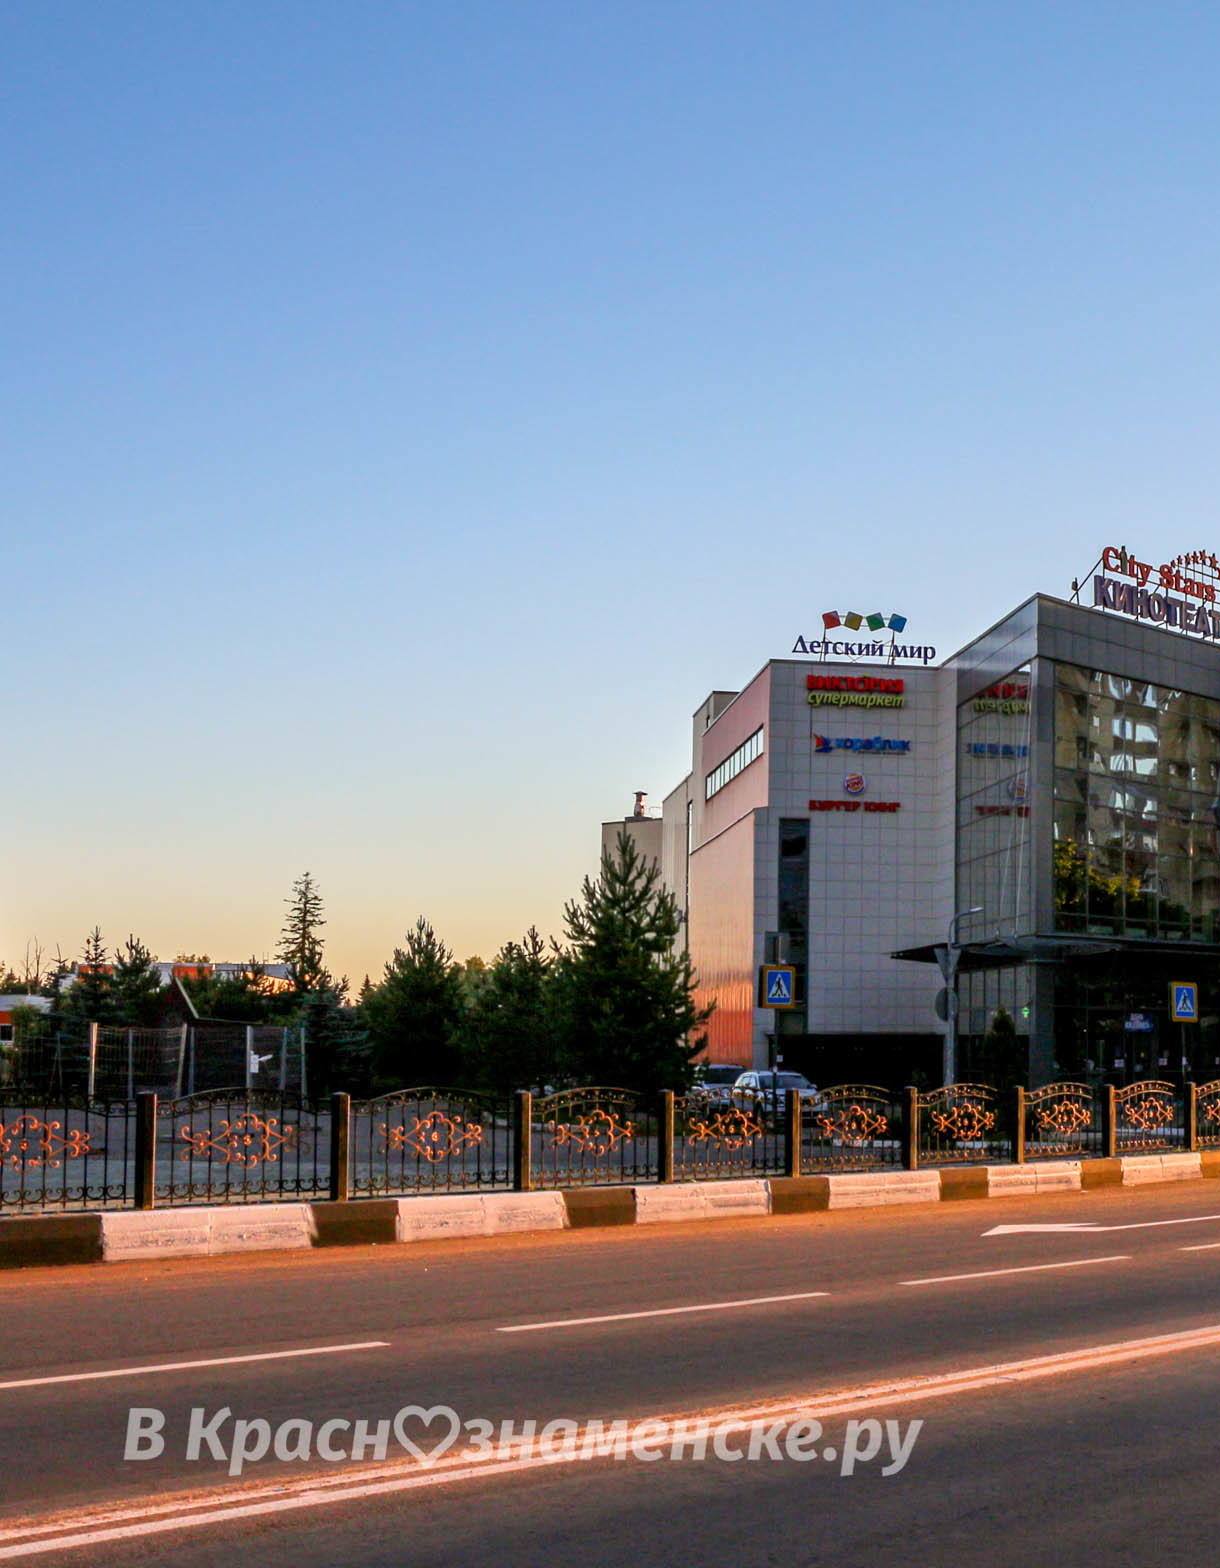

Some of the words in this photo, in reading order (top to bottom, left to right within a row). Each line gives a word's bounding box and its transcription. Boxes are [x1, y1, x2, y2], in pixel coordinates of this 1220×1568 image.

[1102, 545, 1152, 587] City
[1160, 563, 1216, 601] Stars
[792, 635, 884, 657] Детский
[890, 643, 936, 665] мир
[807, 674, 904, 694] ВИКТОРИЯ
[808, 691, 905, 709] супермаркет
